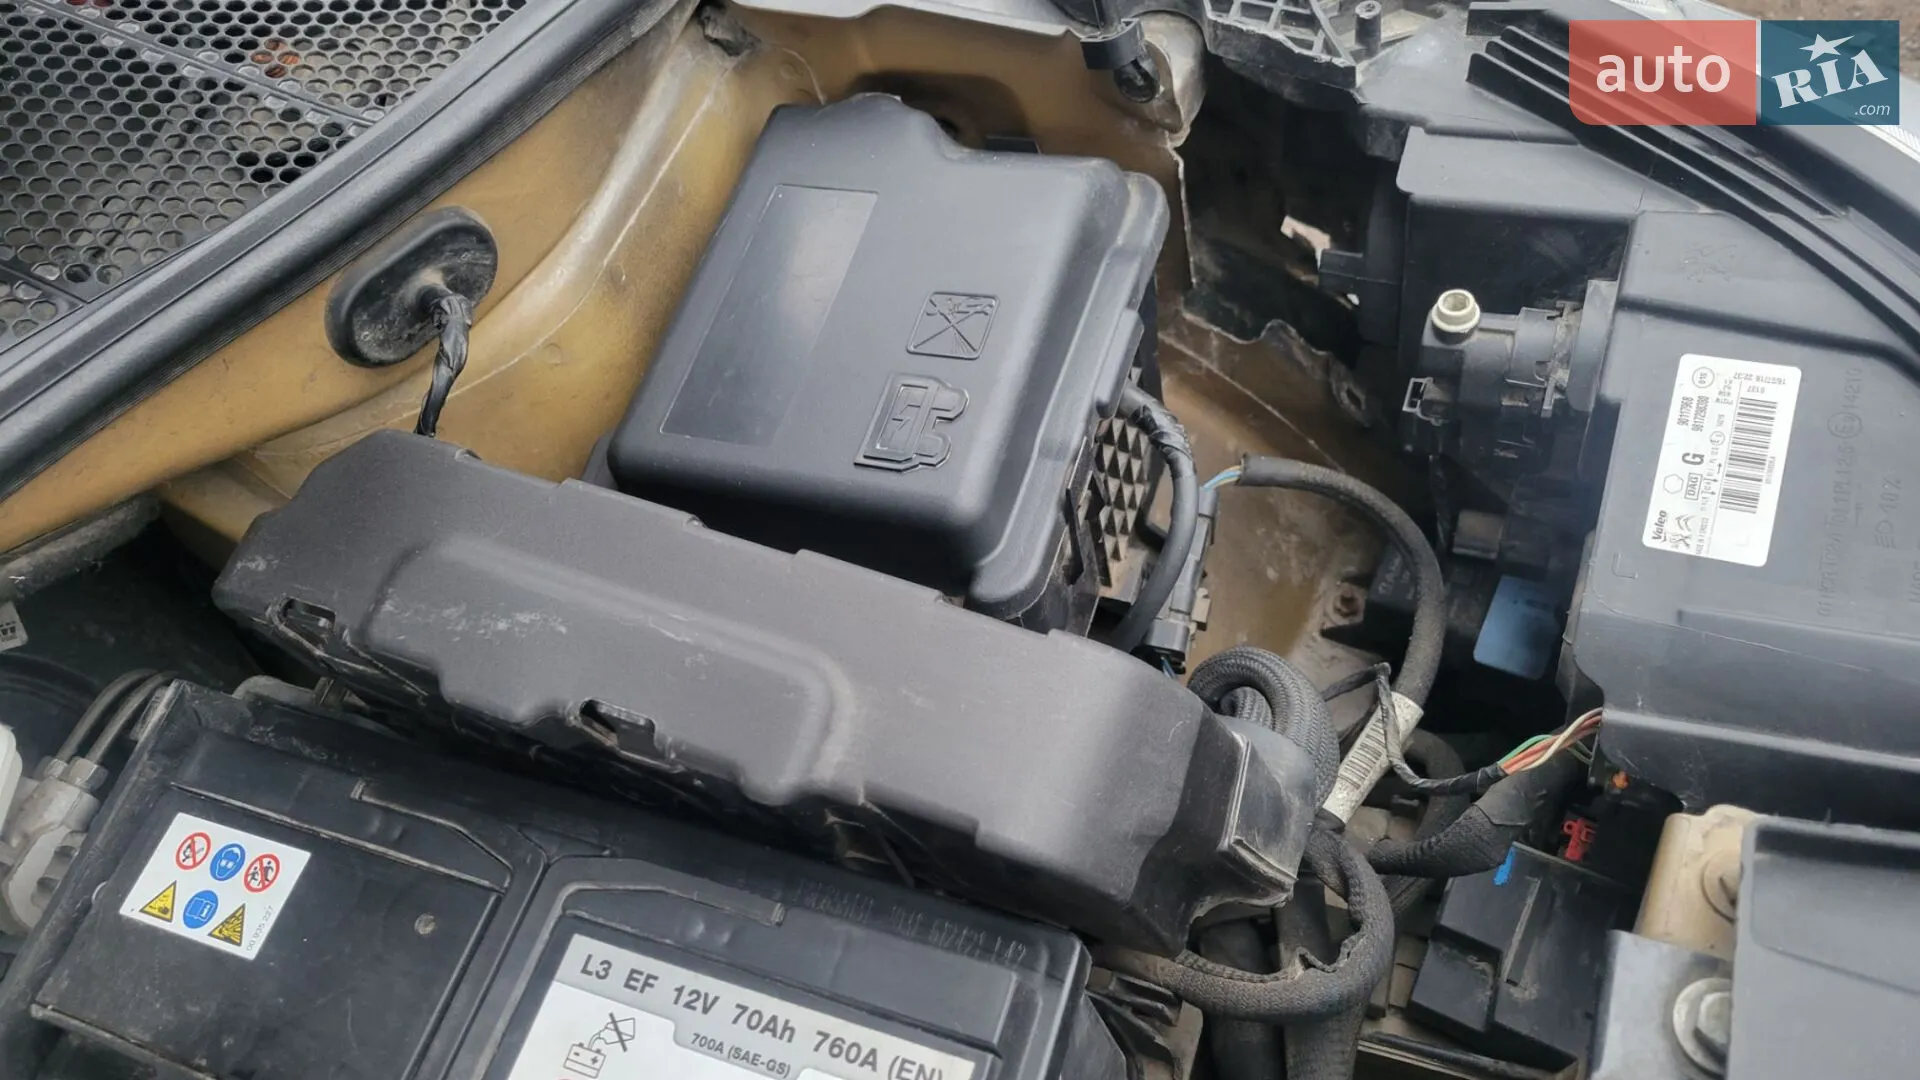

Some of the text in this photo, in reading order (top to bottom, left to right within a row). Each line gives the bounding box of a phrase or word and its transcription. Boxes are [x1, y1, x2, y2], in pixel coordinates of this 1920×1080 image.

[1681, 452, 1705, 466] G
[1651, 509, 1667, 540] Valeo
[580, 953, 613, 980] L3
[623, 967, 660, 994] EF
[672, 985, 720, 1015] 12V
[731, 1003, 796, 1043] 70Ah
[812, 1030, 879, 1072] 760A
[691, 1033, 791, 1079] 700A (SAE-GS)
